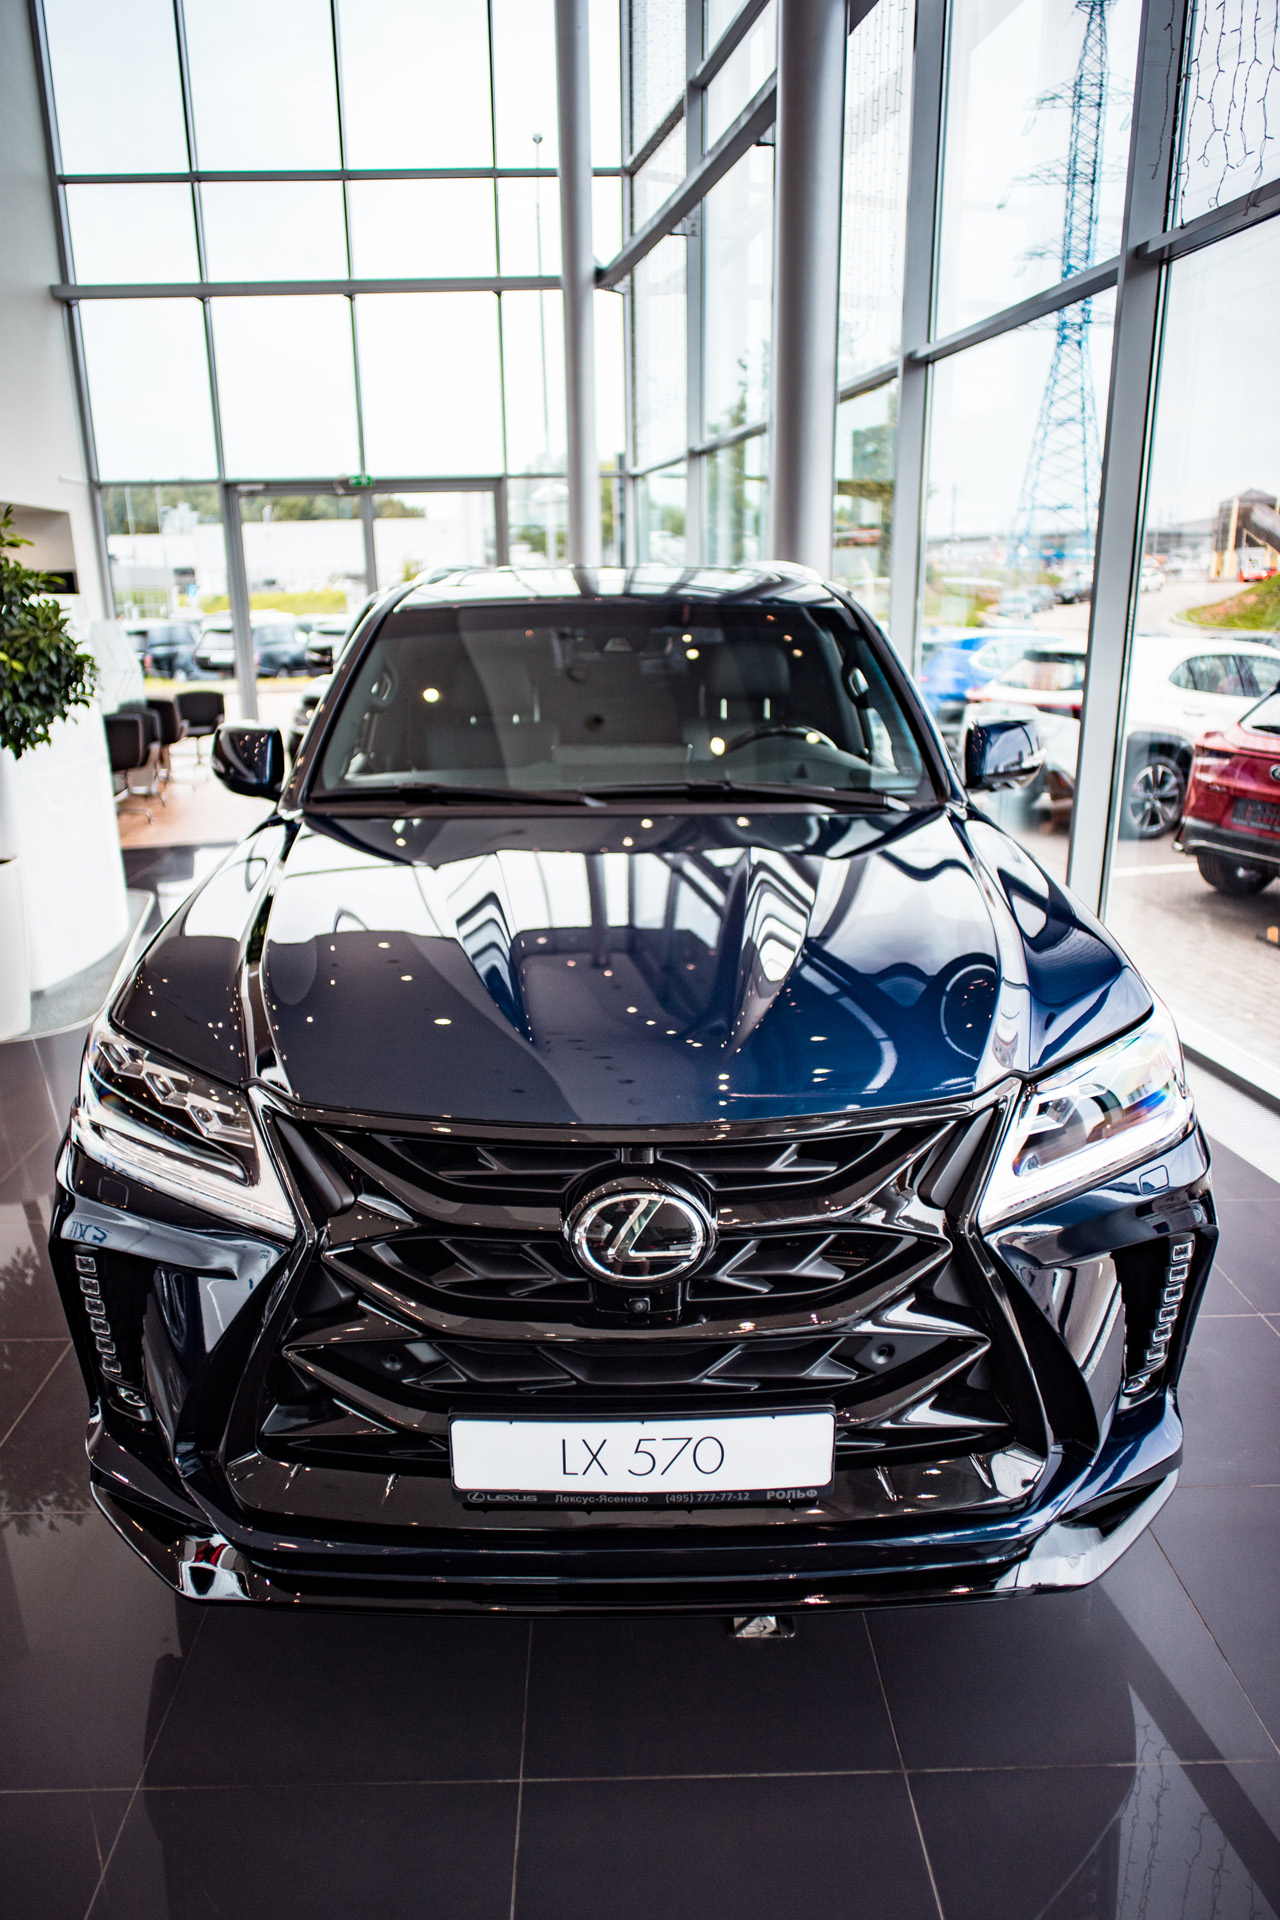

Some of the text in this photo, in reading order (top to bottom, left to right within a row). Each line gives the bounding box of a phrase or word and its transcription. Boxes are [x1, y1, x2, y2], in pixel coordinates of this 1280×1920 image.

[562, 1436, 725, 1476] LX 570
[486, 1494, 538, 1502] LEXUS
[554, 1492, 750, 1504] Лексус-Ясенево (495) 777-77-12
[766, 1489, 818, 1500] РОЛЬФ
